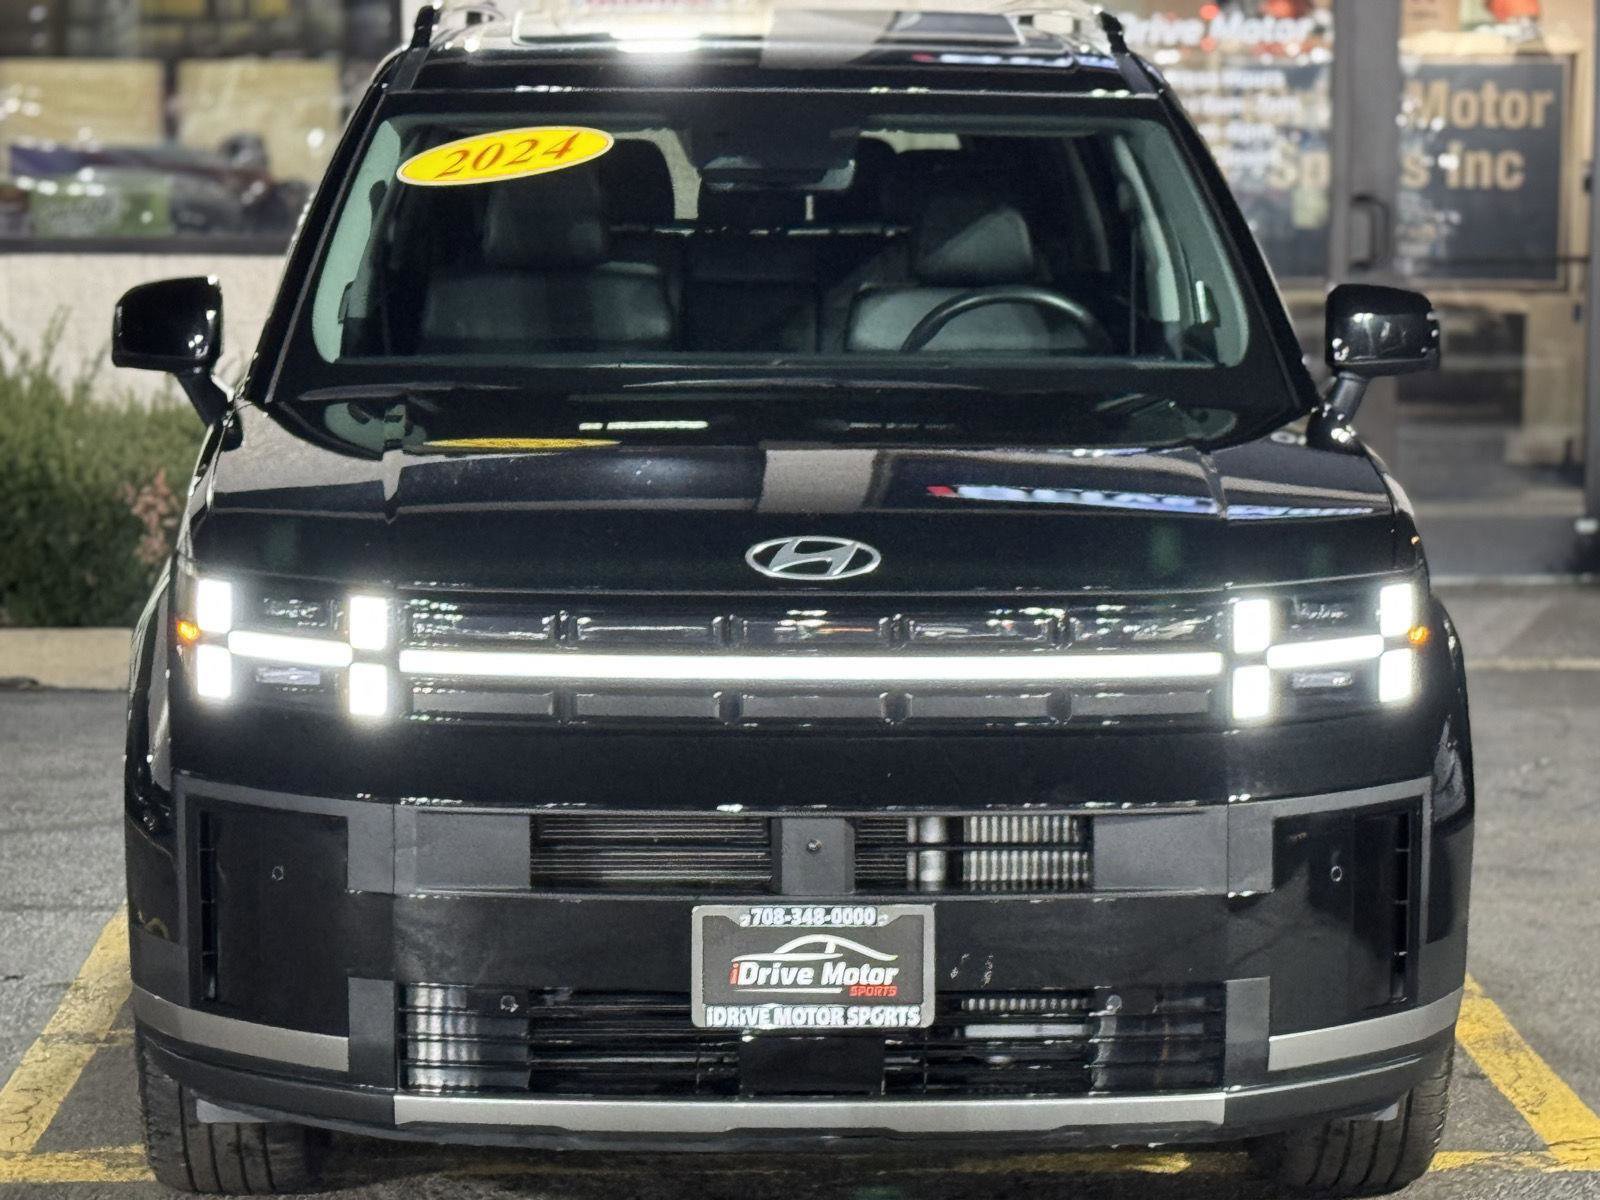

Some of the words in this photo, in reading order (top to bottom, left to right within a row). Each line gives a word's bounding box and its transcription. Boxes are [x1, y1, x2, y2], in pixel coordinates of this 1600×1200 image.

[1402, 79, 1554, 129] Motor
[433, 131, 581, 179] 2024
[750, 906, 877, 926] 708-348-0000
[729, 961, 815, 985] iDrive
[820, 961, 899, 985] Motor
[849, 985, 897, 997] SPORTS
[773, 1005, 845, 1027] MOTOR
[846, 1005, 922, 1027] SPORTS
